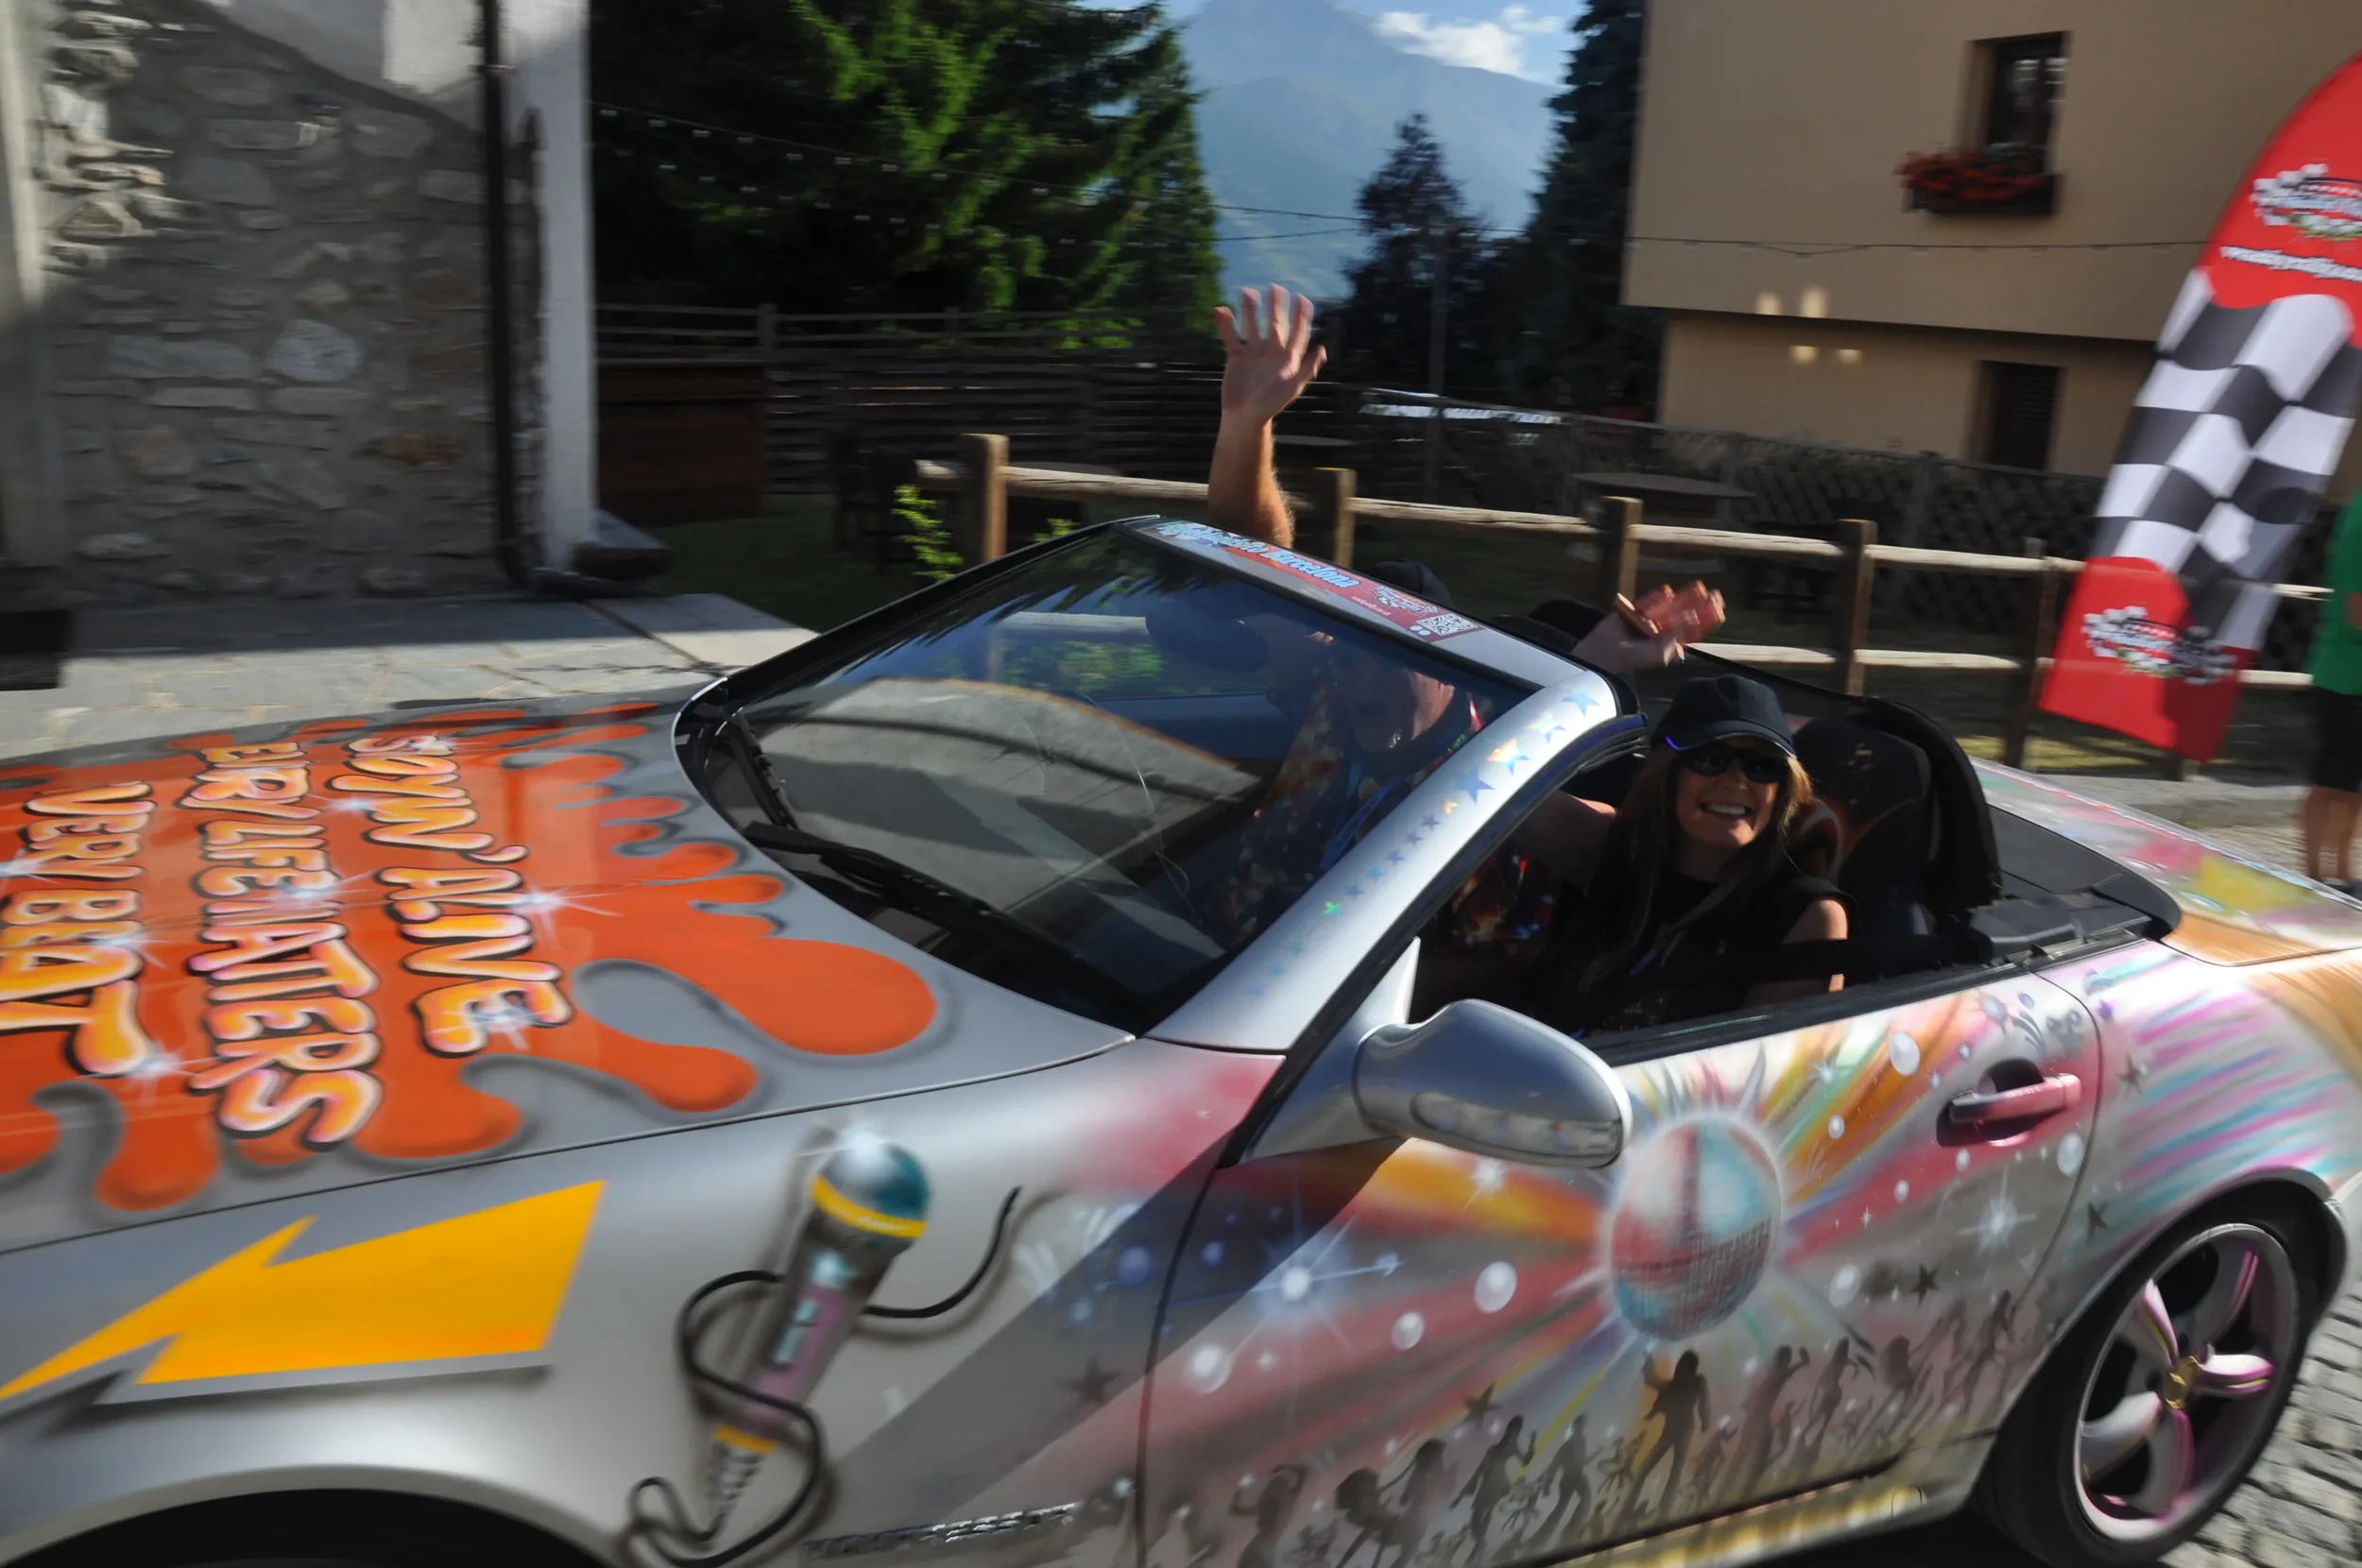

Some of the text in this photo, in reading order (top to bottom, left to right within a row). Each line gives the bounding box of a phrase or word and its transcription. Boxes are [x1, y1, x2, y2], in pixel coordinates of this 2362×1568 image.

[180, 741, 322, 820] EVRY
[14, 781, 157, 880] VERY
[197, 821, 340, 896] LIFE
[379, 866, 572, 1053] ALIVE
